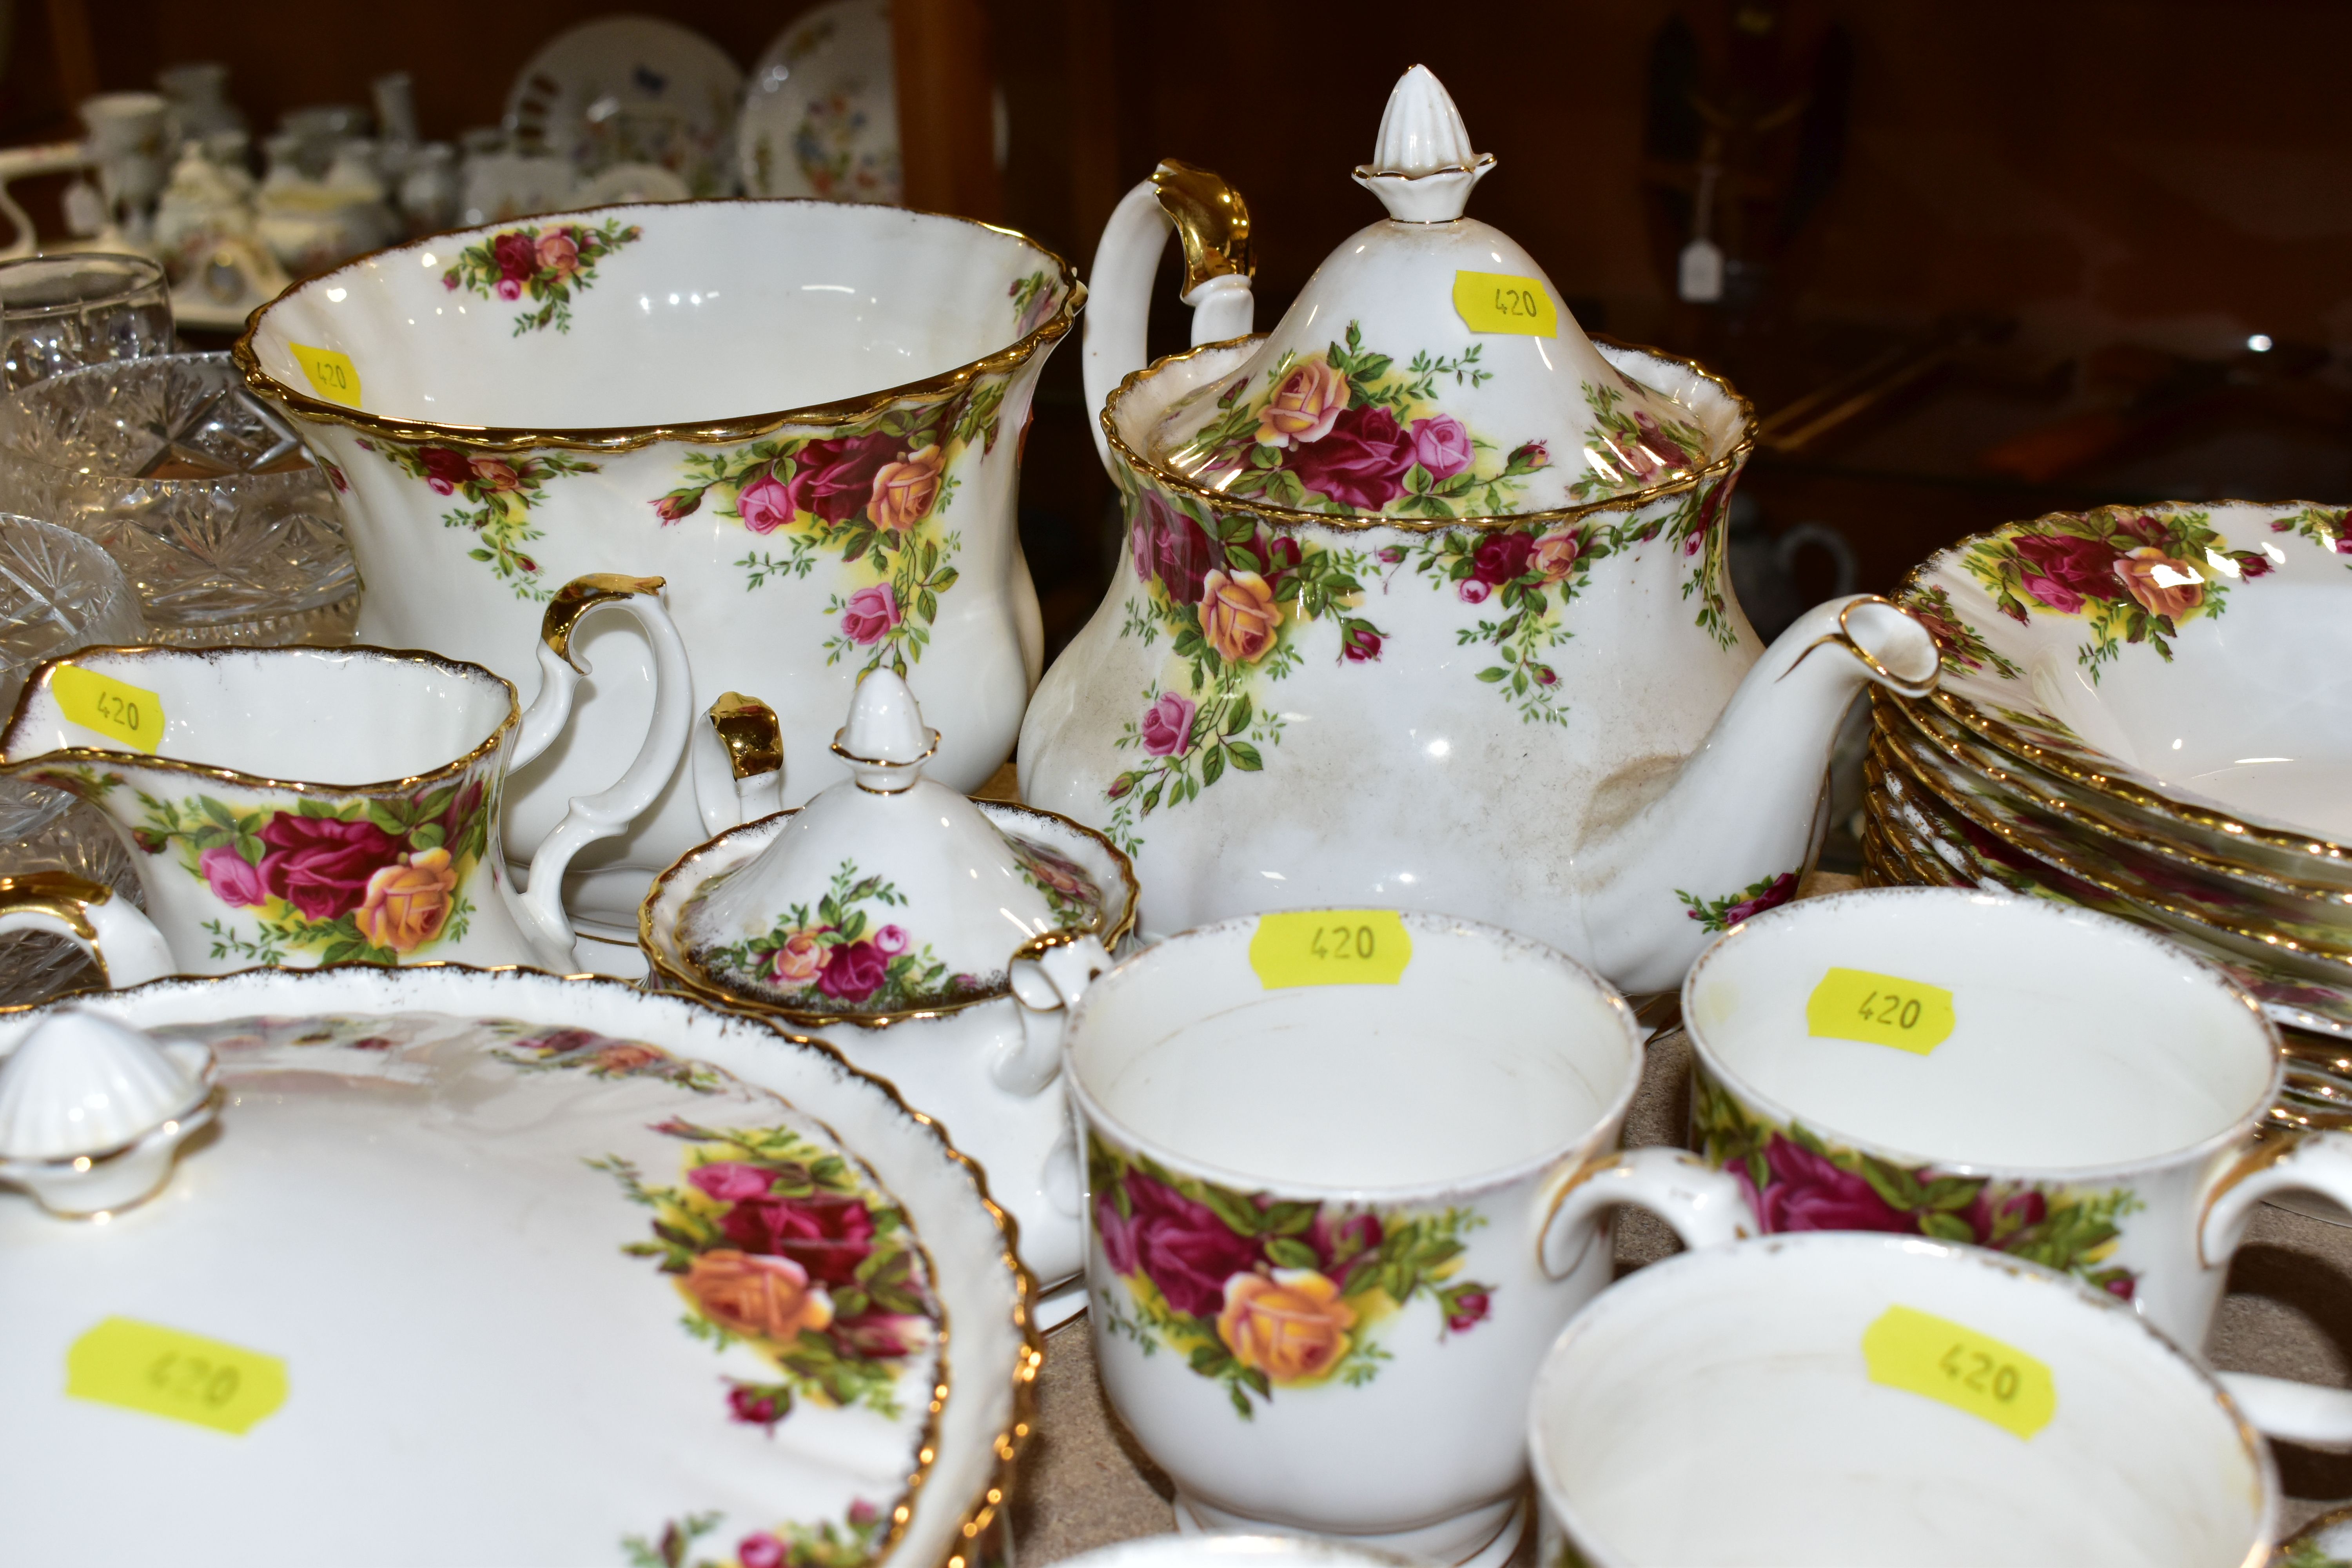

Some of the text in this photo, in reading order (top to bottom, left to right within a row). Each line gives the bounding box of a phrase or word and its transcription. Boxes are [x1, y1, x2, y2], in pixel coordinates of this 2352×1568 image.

[1495, 289, 1536, 317] 420
[317, 362, 347, 389] 420
[98, 691, 139, 730] 420
[1310, 925, 1374, 960] 420
[1858, 990, 1921, 1030] 420
[1938, 1342, 2021, 1404] 420
